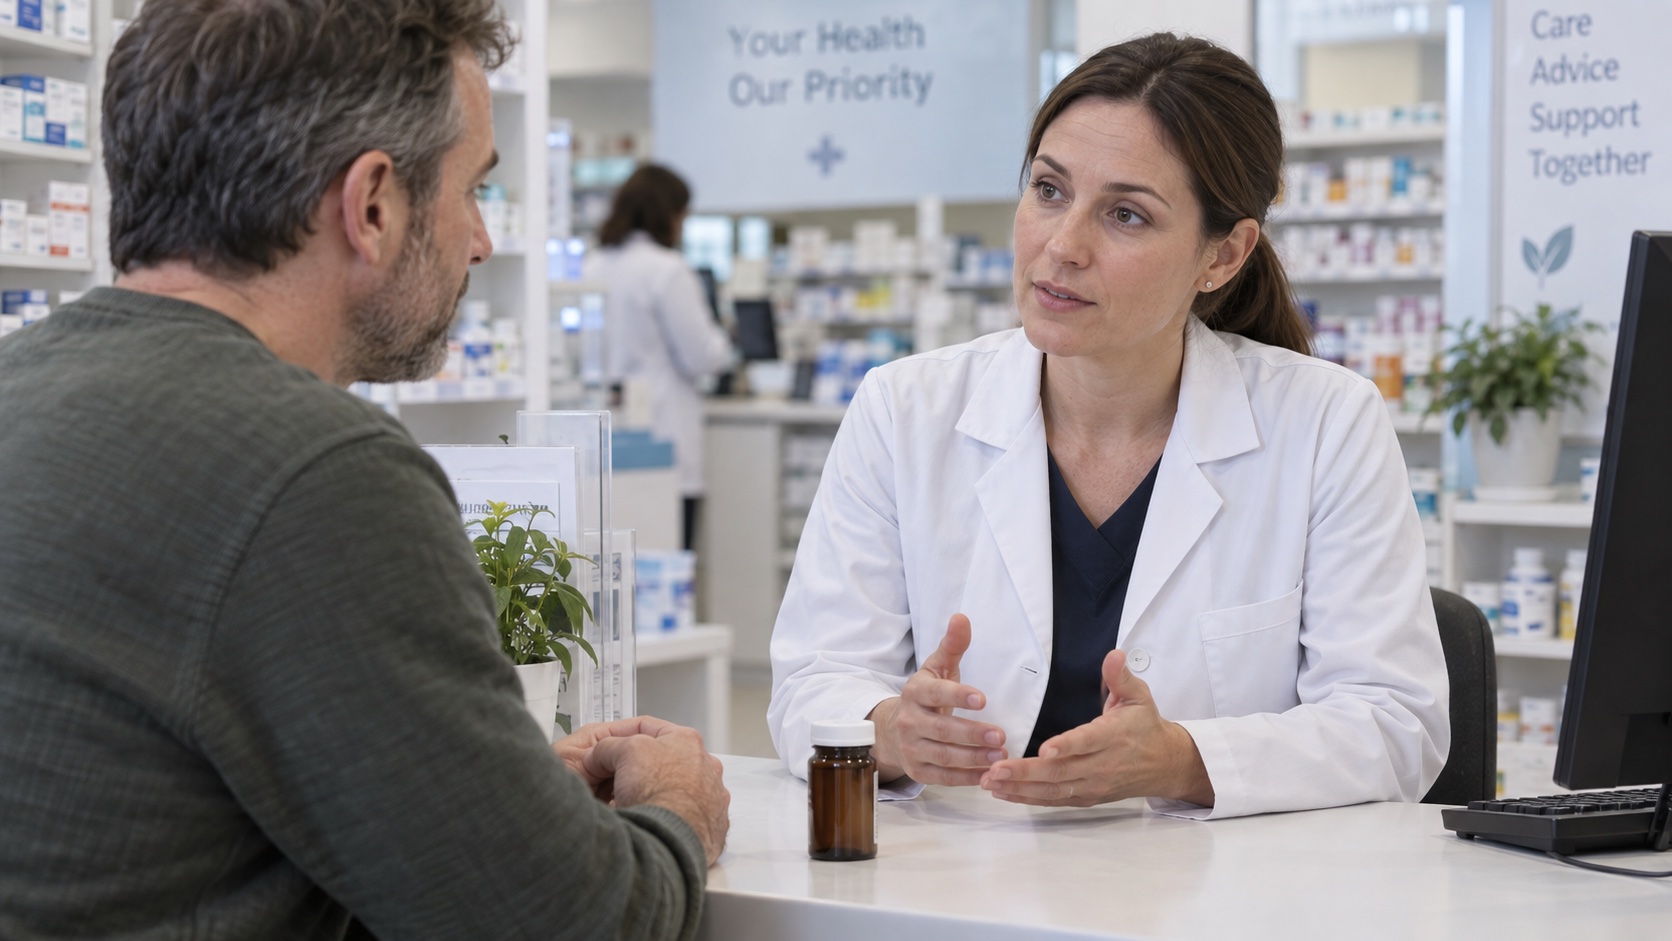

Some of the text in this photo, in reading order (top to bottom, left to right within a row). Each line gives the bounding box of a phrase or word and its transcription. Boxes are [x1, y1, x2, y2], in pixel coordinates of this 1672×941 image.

[727, 15, 926, 57] Your Health
[1531, 9, 1593, 39] Care
[728, 64, 933, 107] Our Priority
[1530, 52, 1620, 84] Advice
[1530, 99, 1640, 136] Support
[1529, 145, 1652, 184] Together
